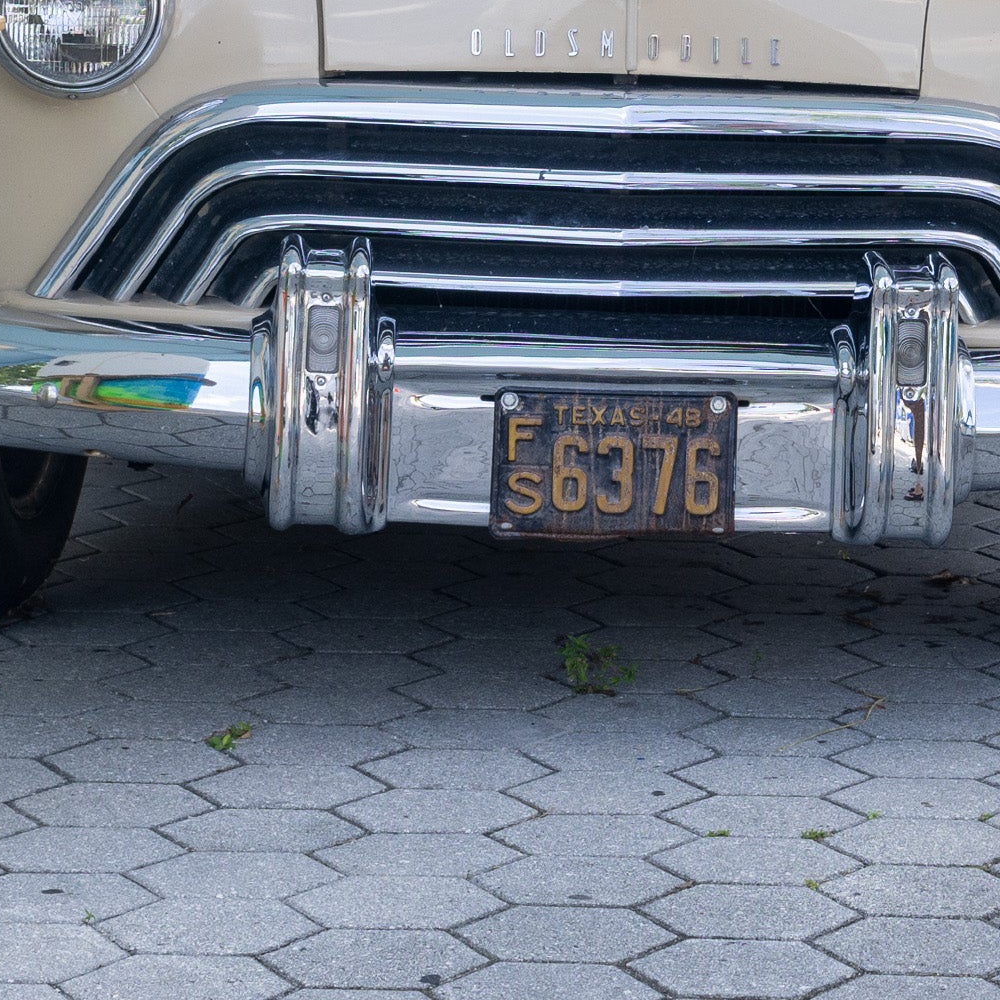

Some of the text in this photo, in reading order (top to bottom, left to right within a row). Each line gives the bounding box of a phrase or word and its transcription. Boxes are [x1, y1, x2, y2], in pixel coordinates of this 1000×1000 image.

[470, 28, 782, 66] OLDSMOBILE
[507, 416, 543, 462] F
[504, 471, 544, 515] S
[551, 434, 721, 516] 6376
